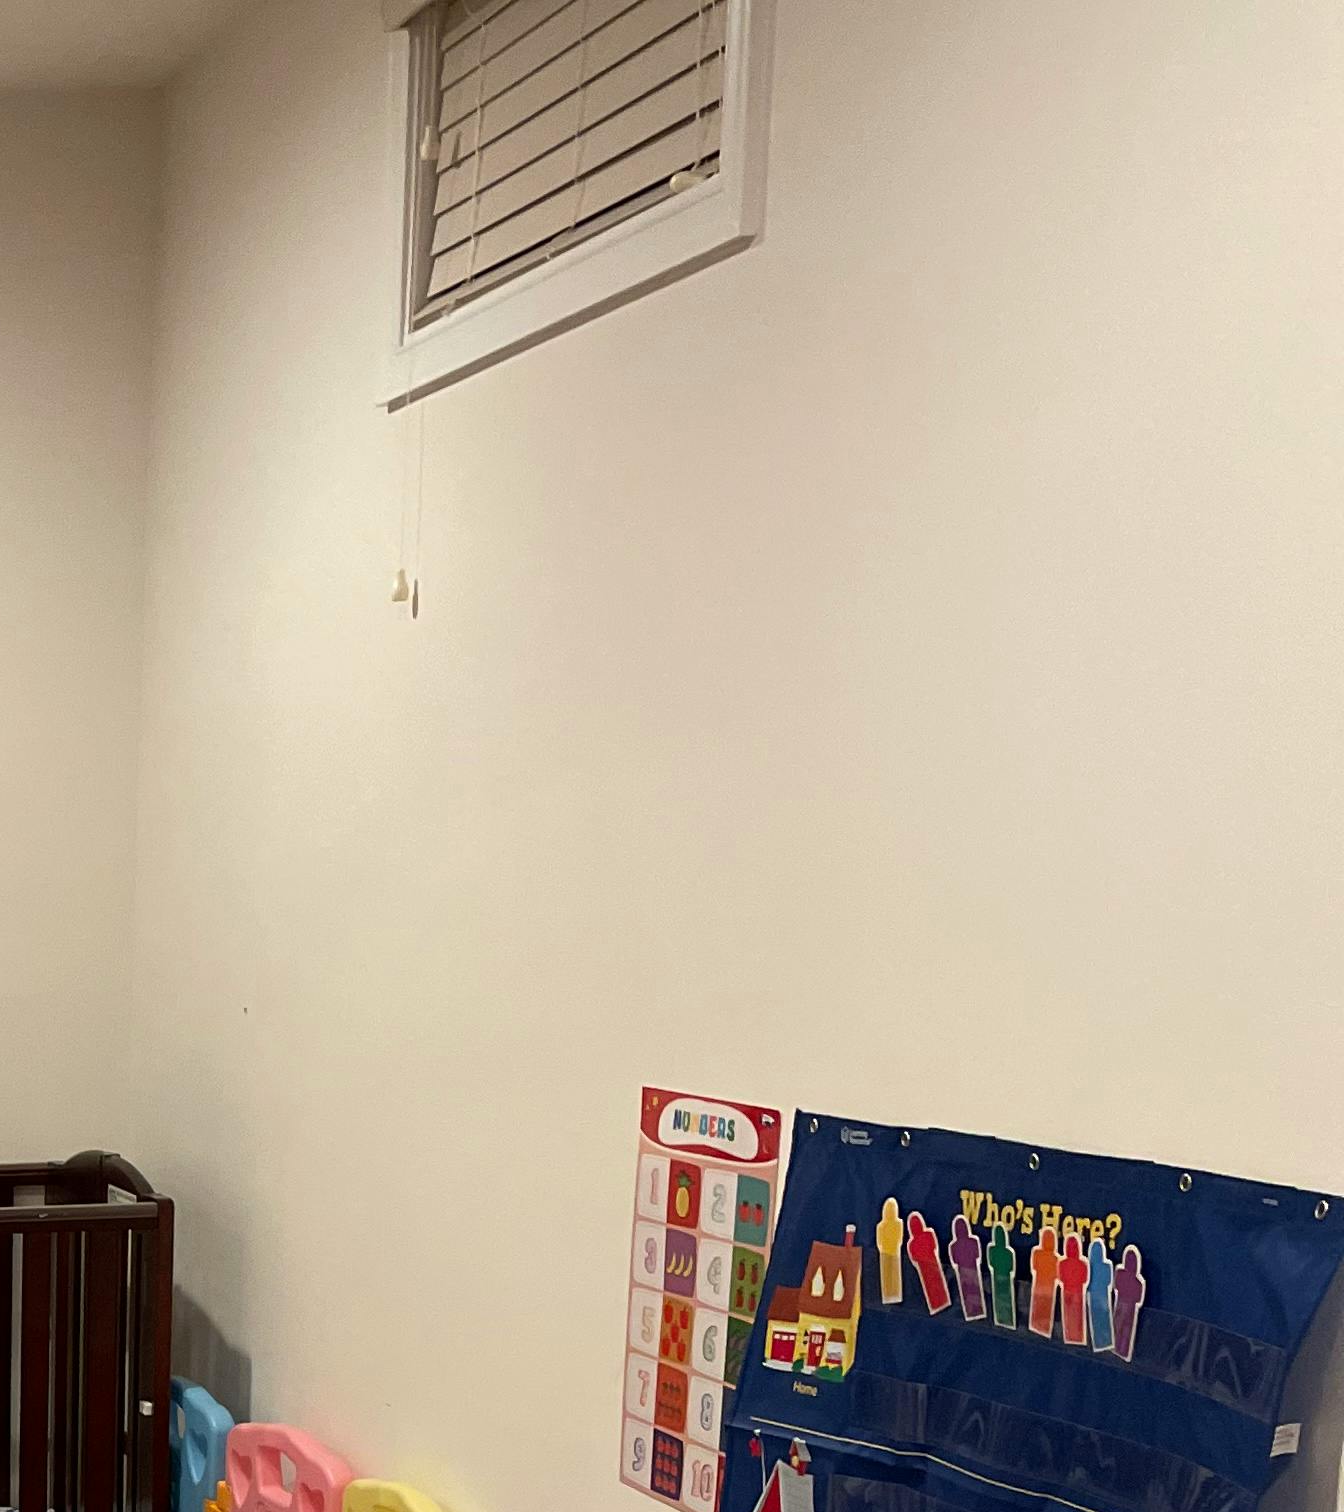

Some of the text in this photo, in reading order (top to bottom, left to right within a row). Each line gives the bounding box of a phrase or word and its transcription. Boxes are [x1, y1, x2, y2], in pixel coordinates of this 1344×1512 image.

[649, 1167, 660, 1206] 1
[711, 1183, 728, 1224] 2
[960, 1189, 1123, 1250] Who's Here?
[643, 1237, 658, 1274] 3
[707, 1256, 723, 1295] 4
[641, 1305, 657, 1344] 5
[702, 1325, 718, 1362] 6
[637, 1368, 650, 1408] 7
[792, 1380, 818, 1398] Home
[700, 1393, 714, 1431] 8
[631, 1436, 647, 1472] 9
[690, 1458, 713, 1502] 10
